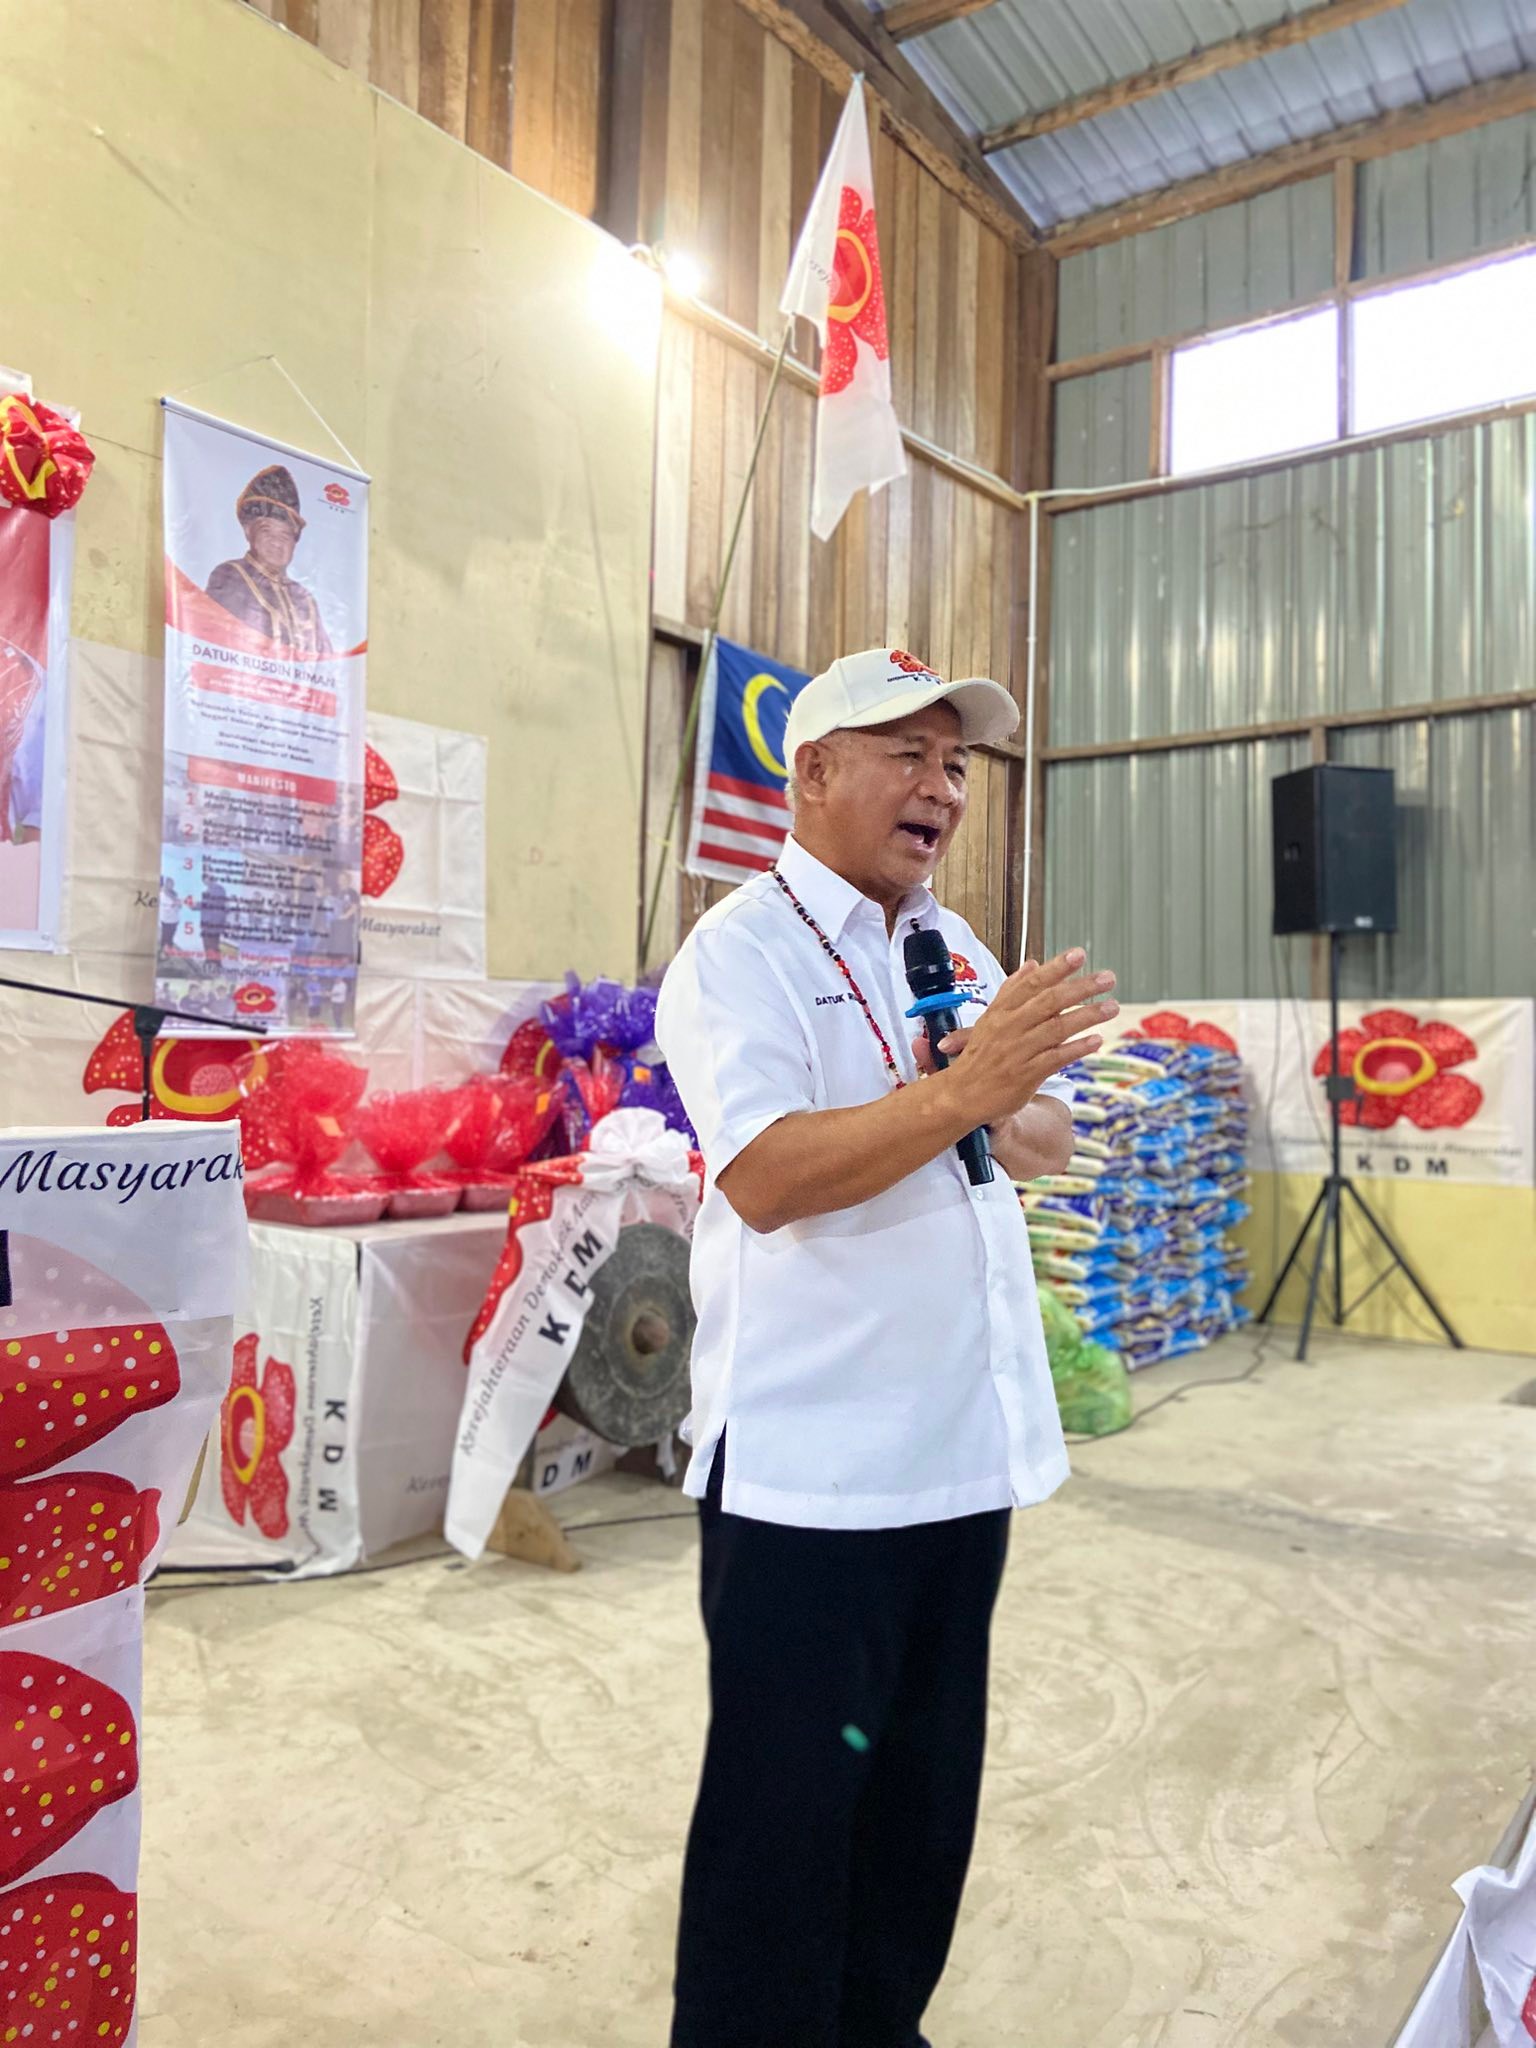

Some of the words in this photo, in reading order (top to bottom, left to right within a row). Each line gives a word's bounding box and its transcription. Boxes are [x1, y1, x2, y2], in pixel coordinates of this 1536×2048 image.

[192, 643, 239, 666] DATUK
[242, 656, 291, 679] RUSDIN
[238, 772, 297, 793] MANIFESTO
[186, 792, 195, 806] 1
[184, 823, 194, 837] 2
[183, 857, 194, 871] 3
[184, 895, 194, 908] 4
[183, 921, 194, 935] 5
[815, 993, 847, 1006] DATUK
